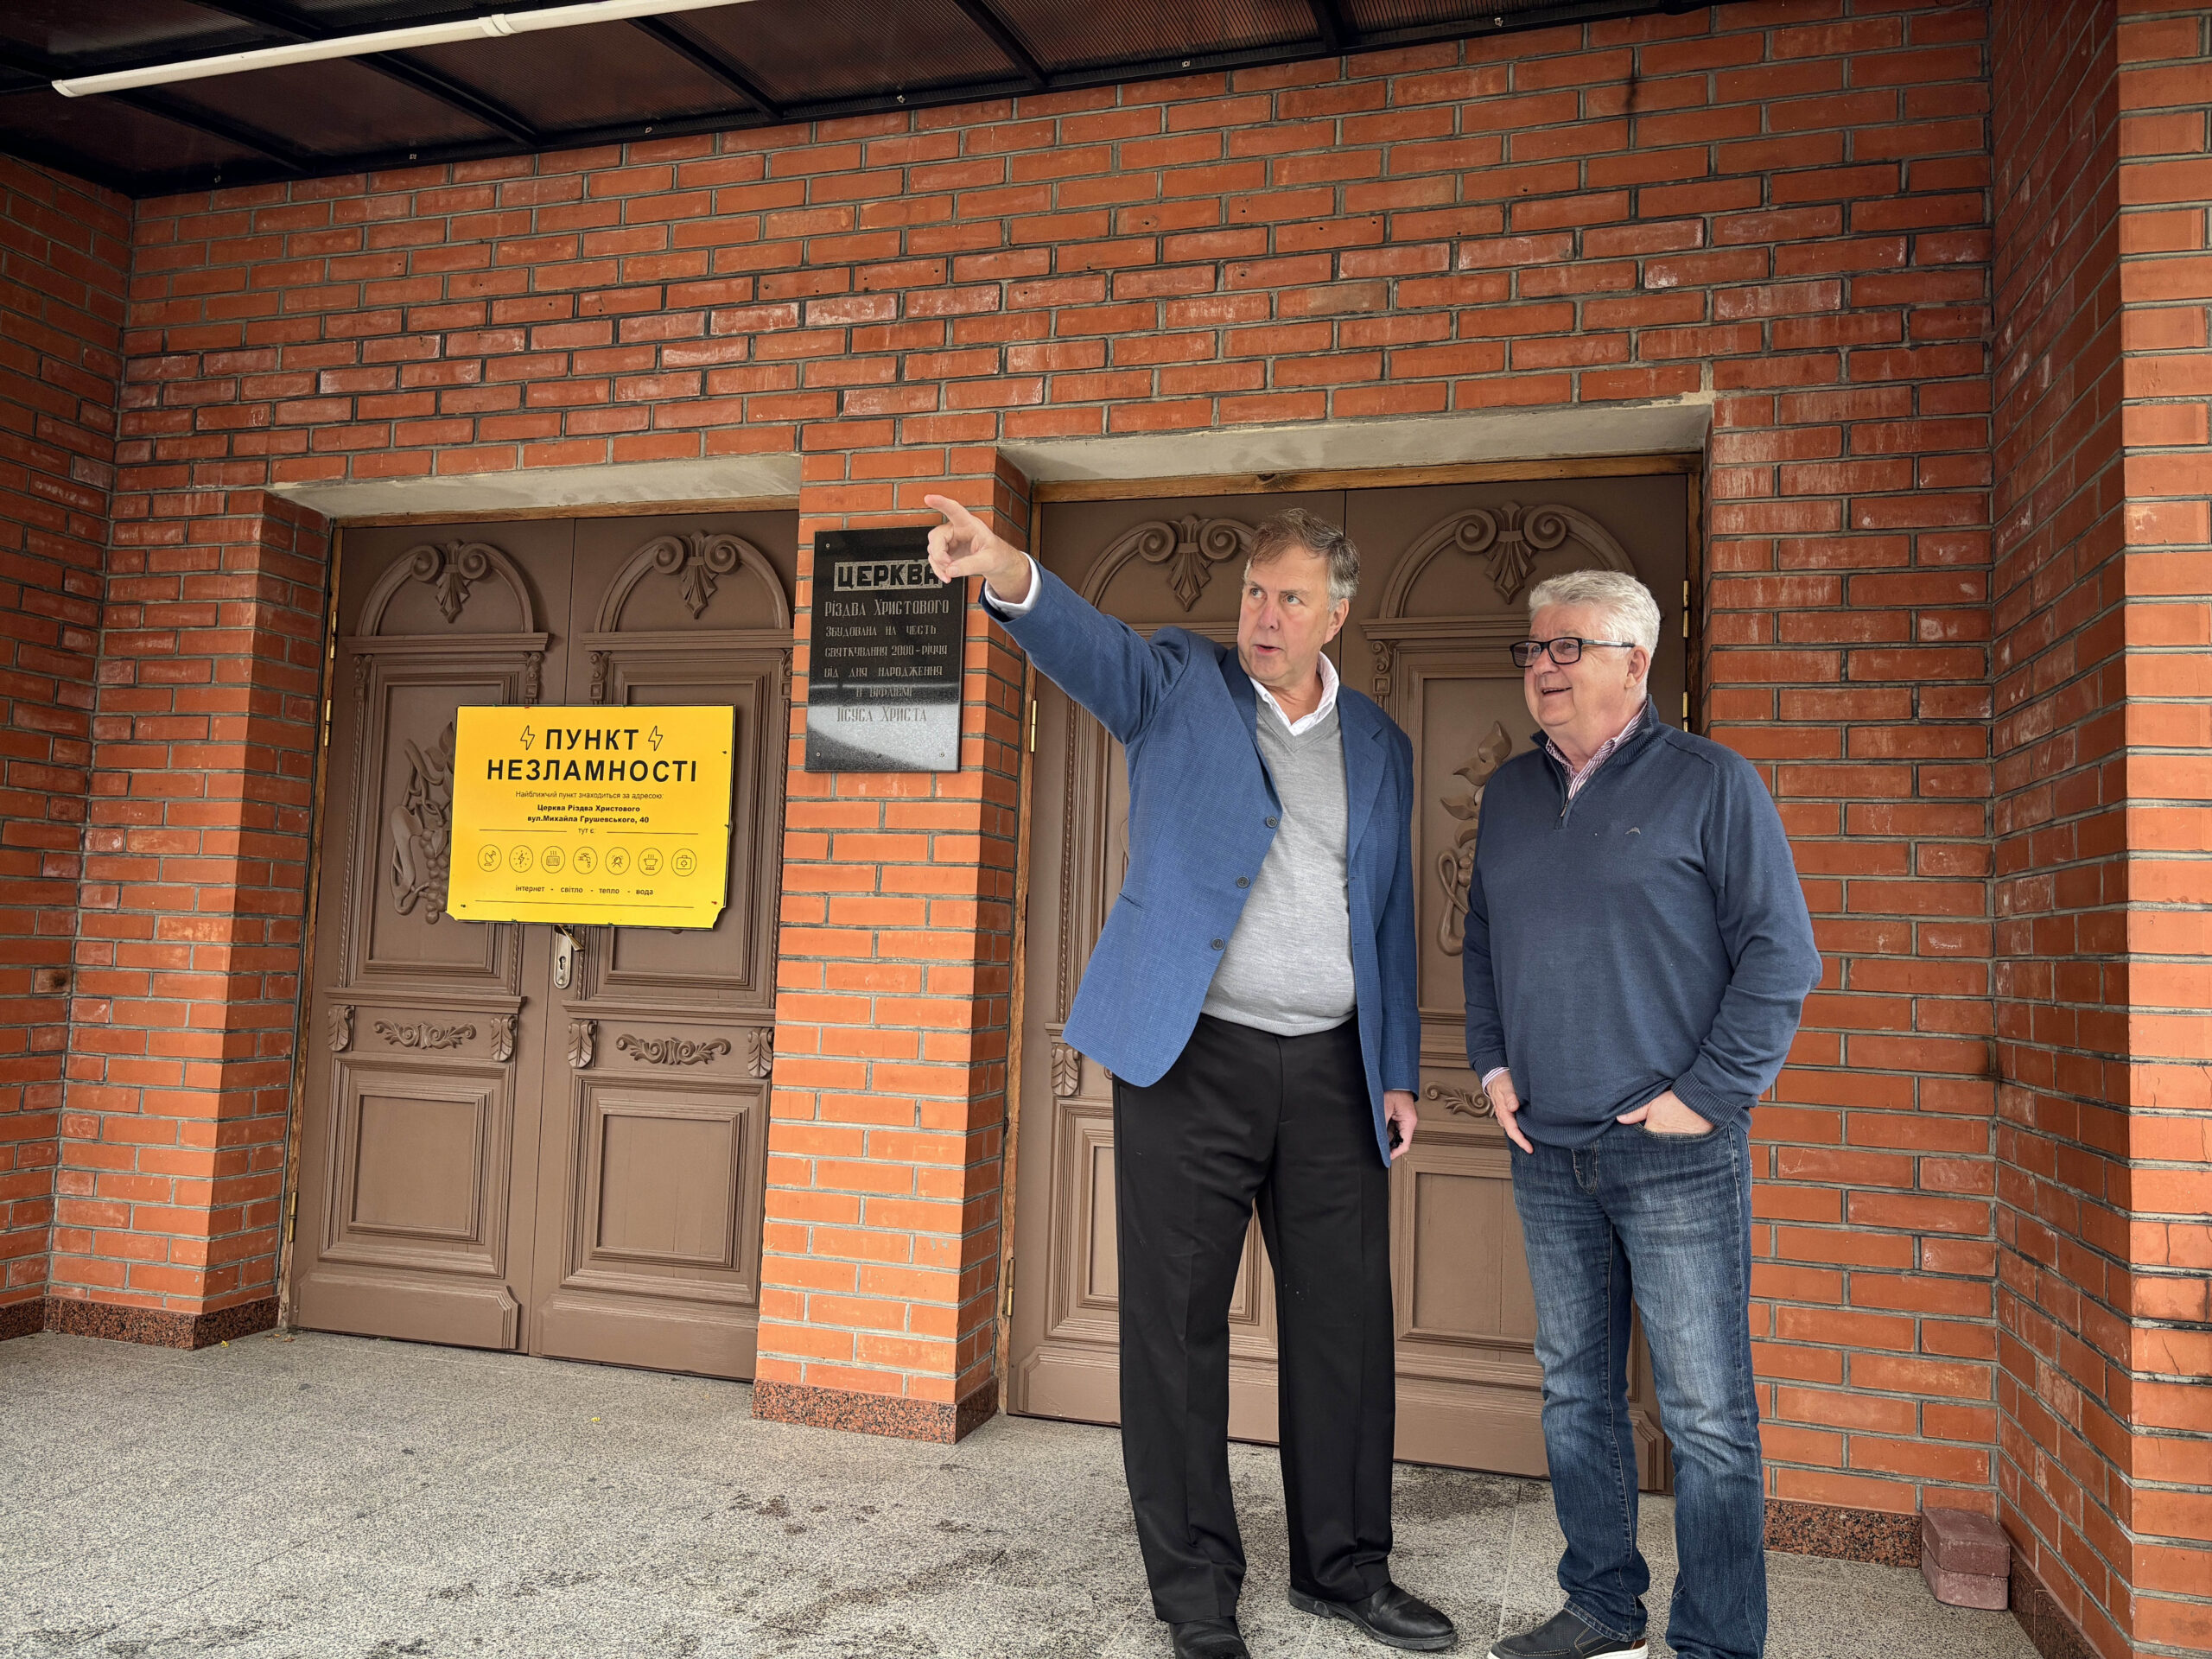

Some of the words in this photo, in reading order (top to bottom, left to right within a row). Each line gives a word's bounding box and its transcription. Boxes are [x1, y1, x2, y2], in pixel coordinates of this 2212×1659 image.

[838, 564, 938, 589] ЦЕРКВА
[826, 626, 877, 638] ЗБУДОВАНА
[886, 626, 897, 636] НА
[906, 626, 937, 635] ЧЕСТЬ
[824, 666, 839, 678] ВІД
[849, 667, 868, 678] ДНЯ
[879, 666, 943, 677] НАРОДЖЕННЯ
[546, 729, 639, 751] ПУНКТ
[487, 760, 696, 783] НЕЗЛАМНОСТІ
